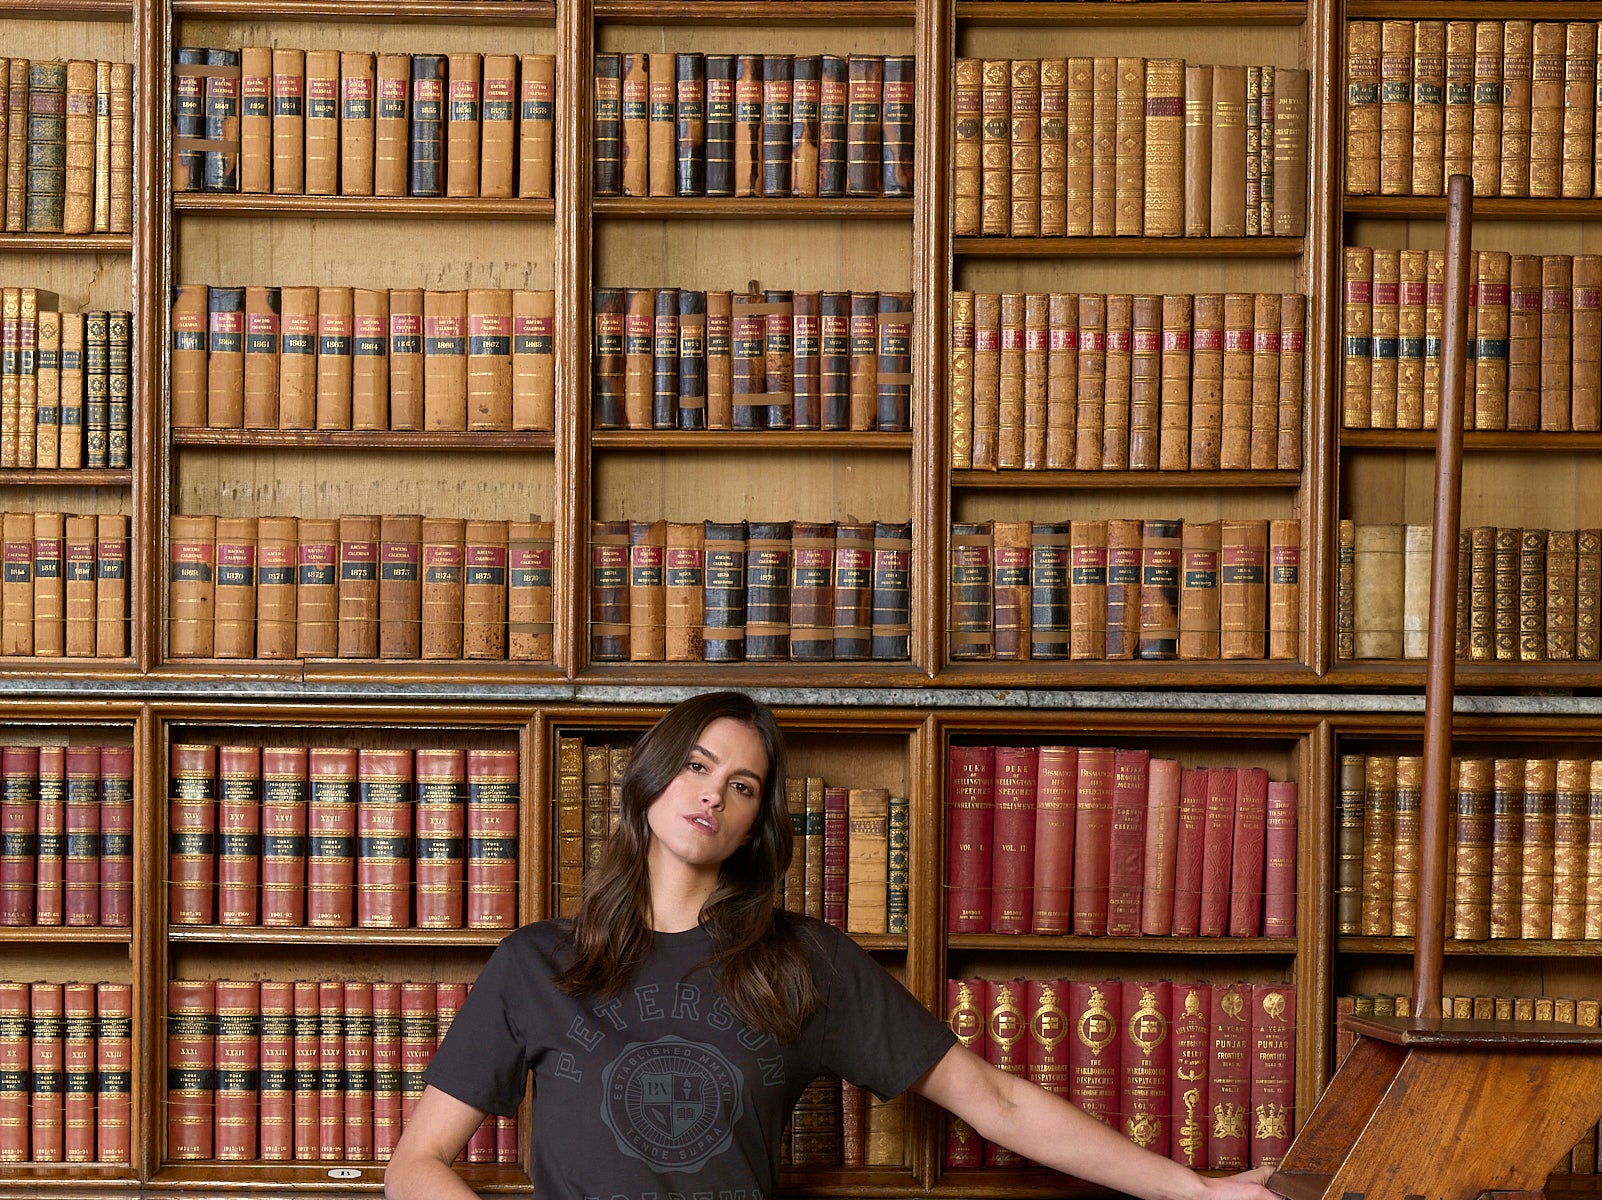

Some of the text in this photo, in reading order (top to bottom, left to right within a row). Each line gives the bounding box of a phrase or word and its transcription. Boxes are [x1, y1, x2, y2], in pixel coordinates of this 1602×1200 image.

[1216, 1040, 1247, 1048] PUNJAB
[614, 1048, 691, 1100] ESTABLISHED
[626, 1128, 722, 1159] TENDE SUPRA
